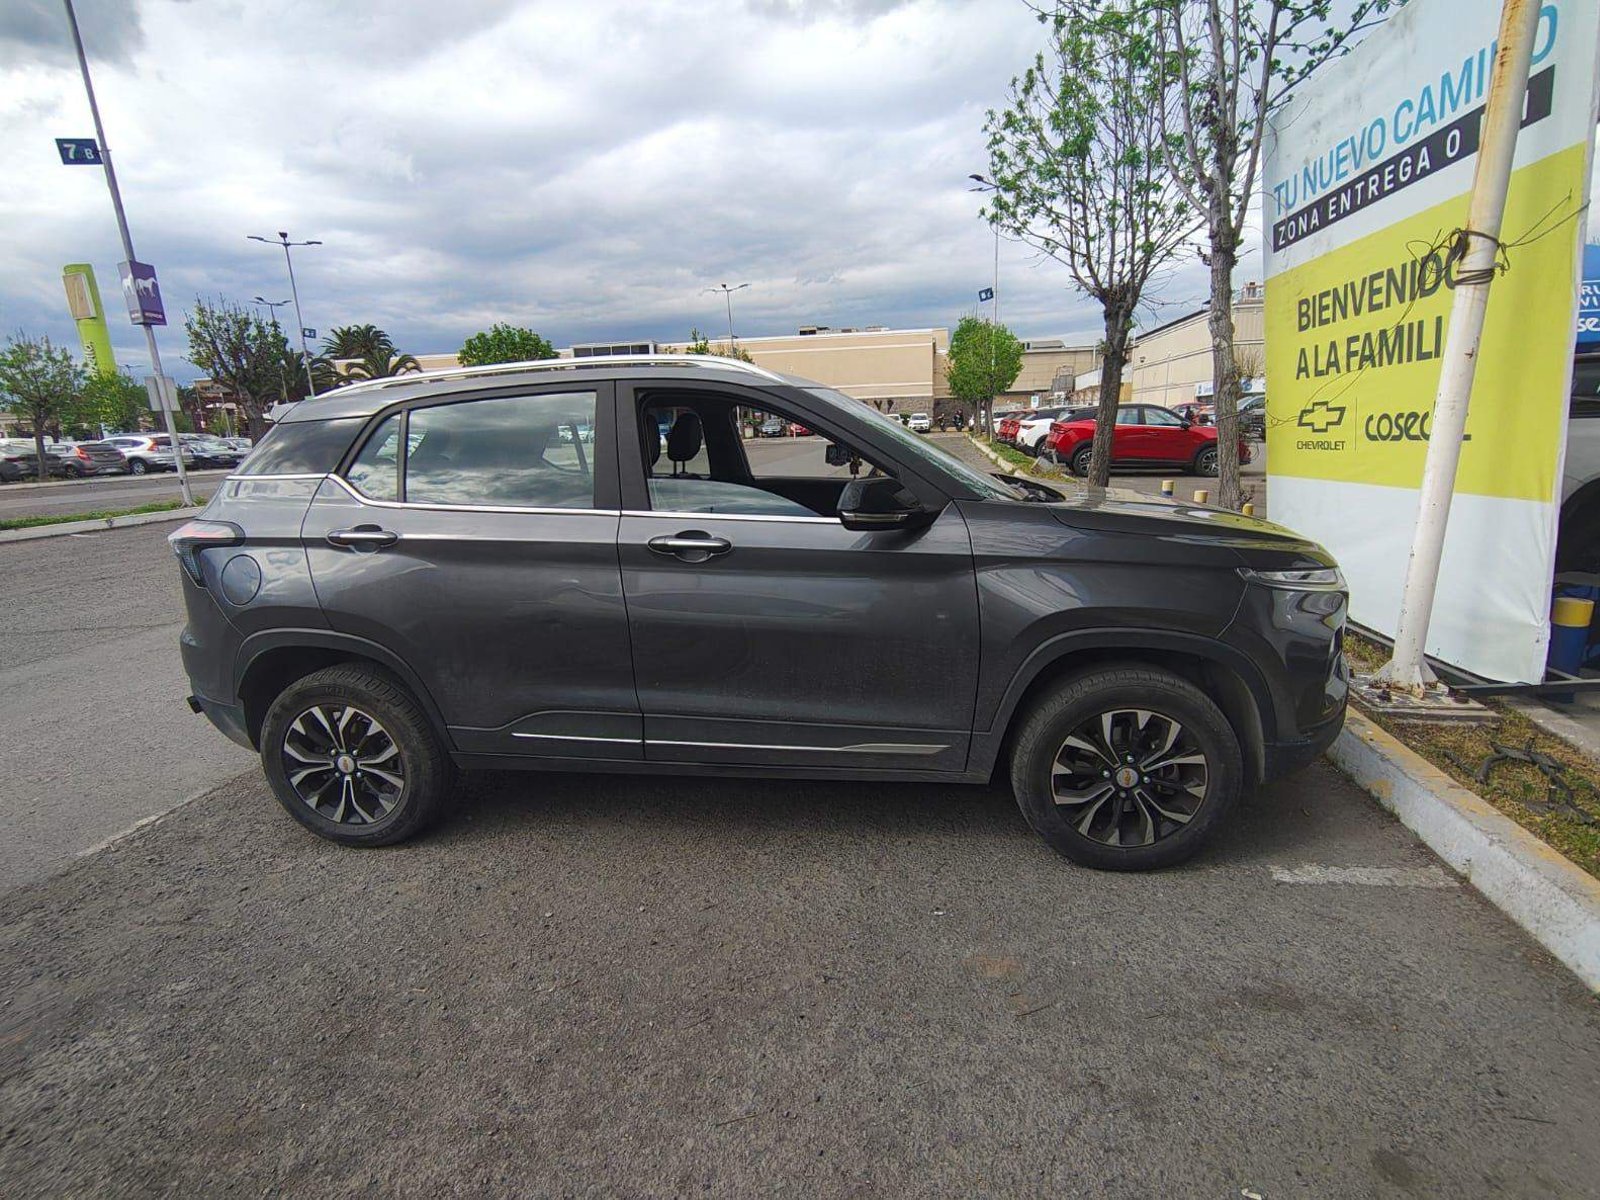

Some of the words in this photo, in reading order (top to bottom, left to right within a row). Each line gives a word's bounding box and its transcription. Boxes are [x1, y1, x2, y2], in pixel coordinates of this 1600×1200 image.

[1274, 174, 1297, 216] TU
[1303, 117, 1386, 201] NUEVO
[1393, 5, 1558, 145] CAMIO
[63, 143, 76, 160] 7
[84, 147, 95, 160] B
[1278, 208, 1320, 246] ZONA
[1328, 146, 1431, 220] ENTREGA
[1296, 347, 1311, 381] A
[1314, 340, 1342, 378] LA
[1345, 315, 1443, 374] FAMILI
[1296, 440, 1346, 451] CHEVROLET
